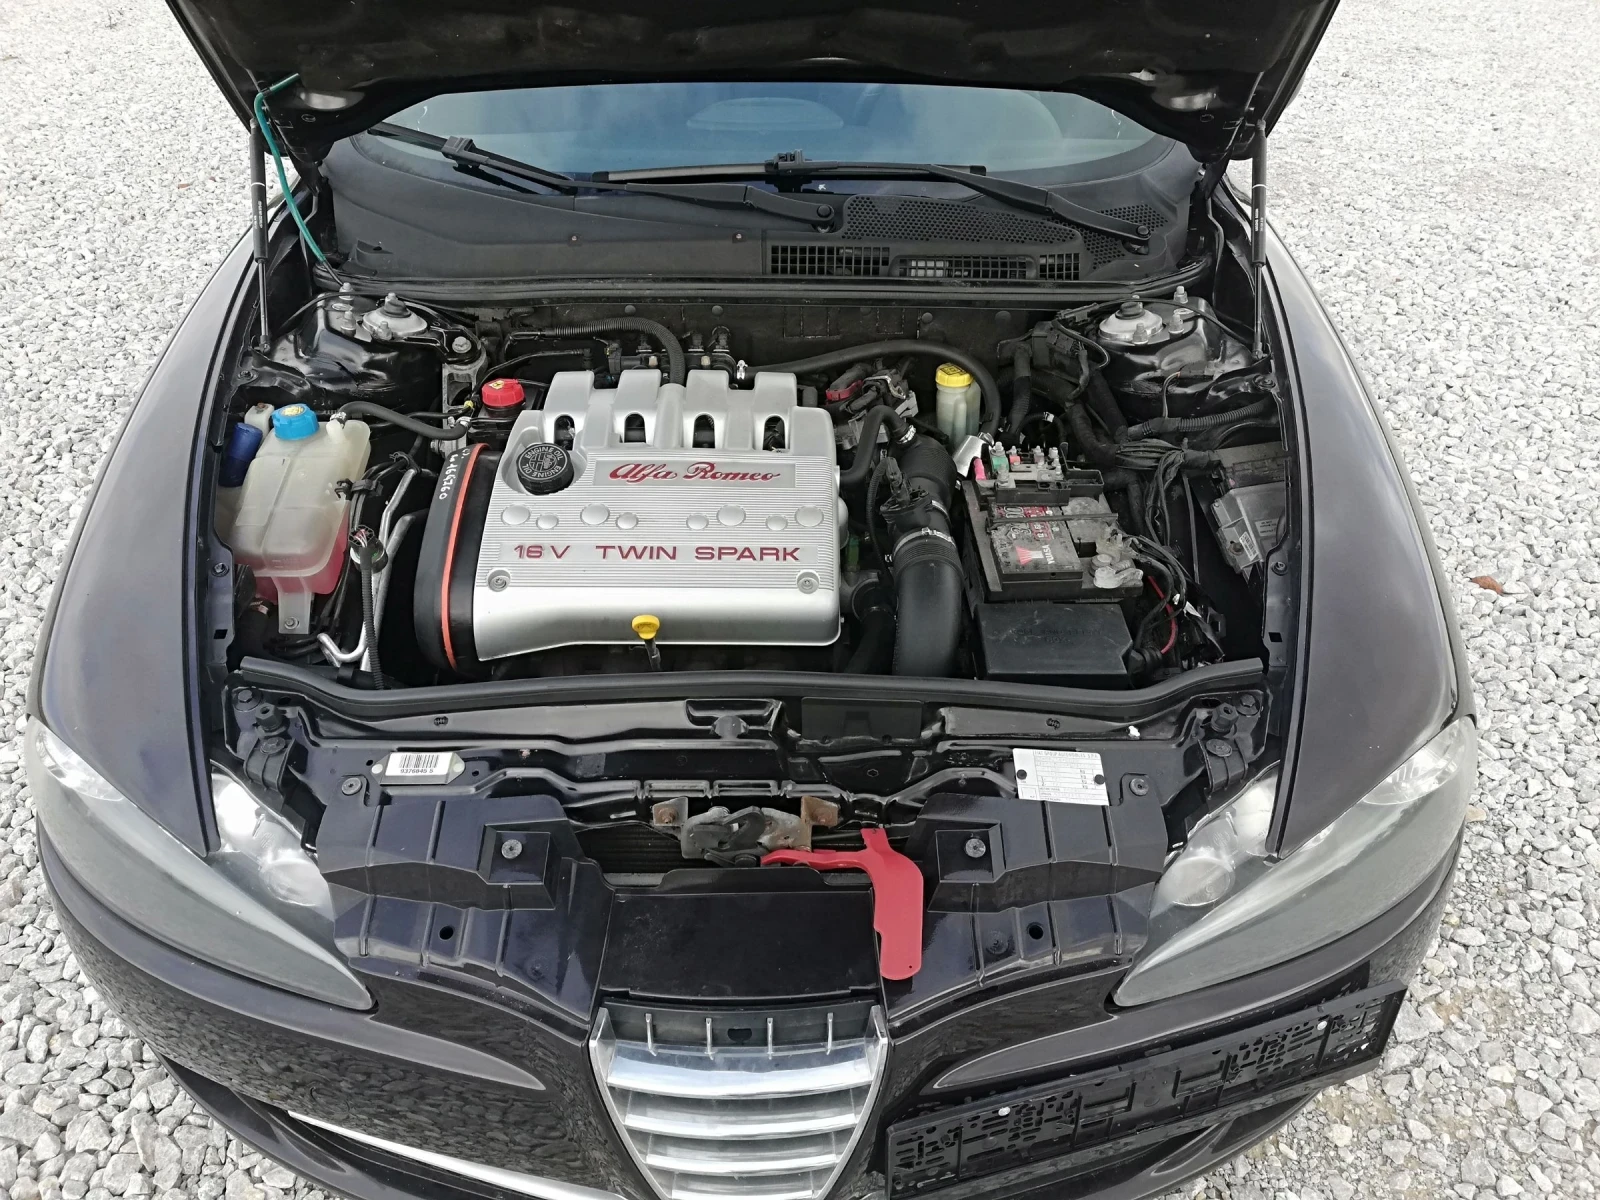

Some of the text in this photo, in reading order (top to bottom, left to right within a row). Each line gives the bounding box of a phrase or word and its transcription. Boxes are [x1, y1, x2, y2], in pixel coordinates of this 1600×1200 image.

[524, 446, 564, 461] ENGINE OIL
[521, 463, 562, 478] ENGINE OIL
[609, 461, 781, 484] Alfa Romeo
[595, 545, 677, 561] TWIN
[694, 546, 800, 562] SPARK
